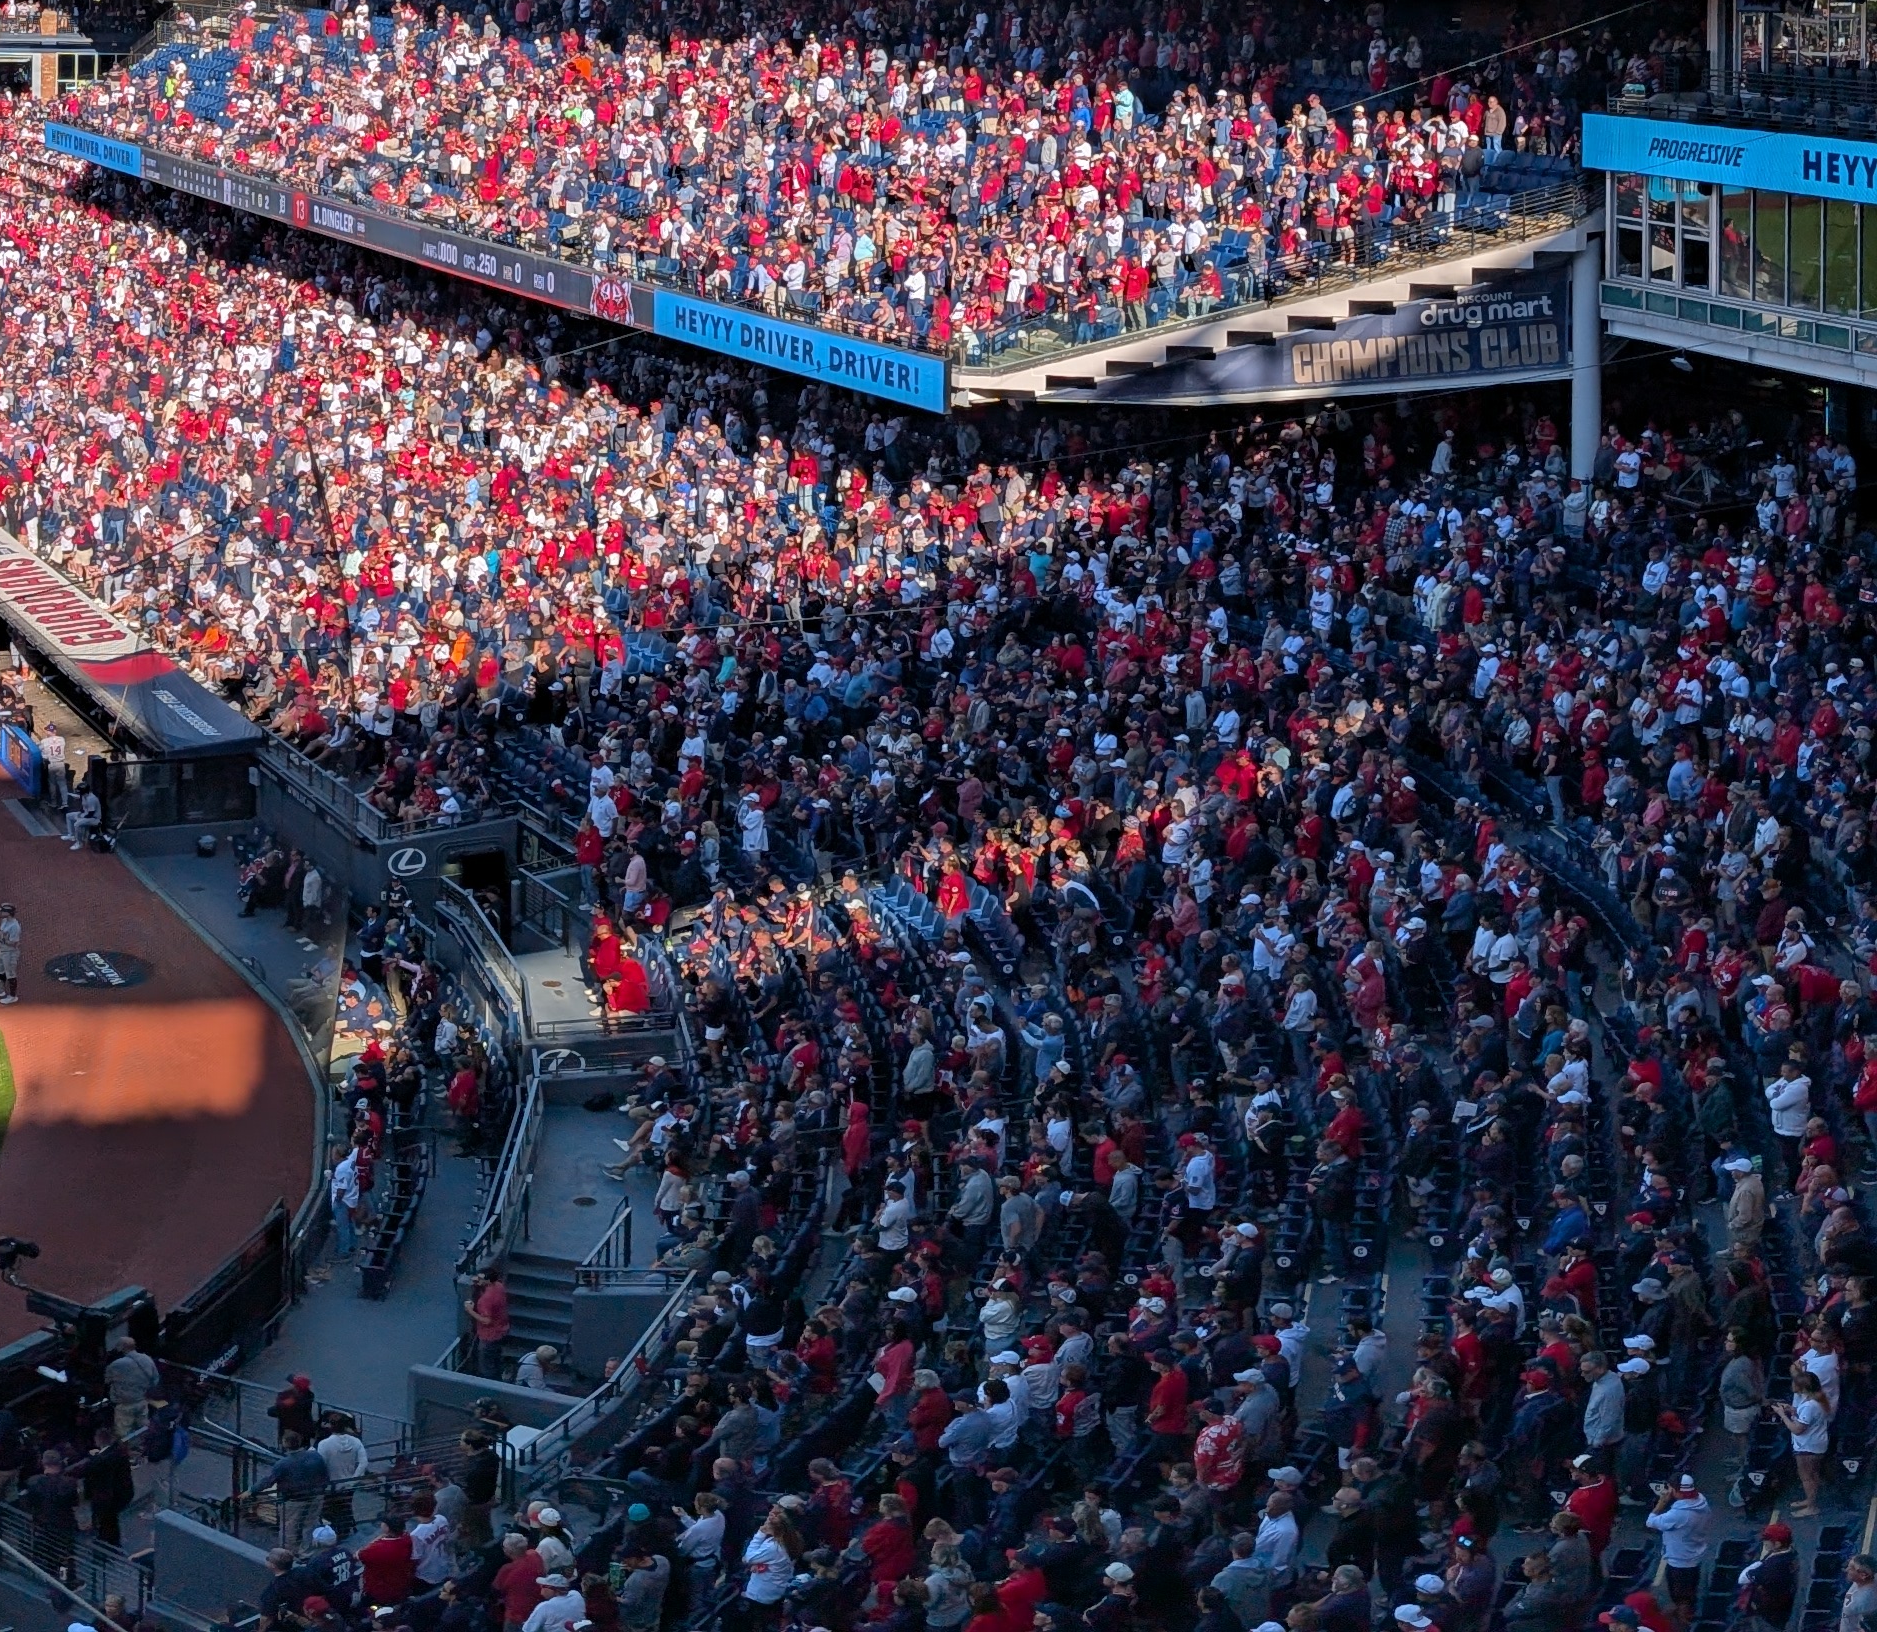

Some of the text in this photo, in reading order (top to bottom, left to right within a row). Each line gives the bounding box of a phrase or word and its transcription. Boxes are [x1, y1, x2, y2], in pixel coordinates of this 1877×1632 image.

[1648, 137, 1746, 167] PROGRESSIVE
[295, 200, 353, 233] 13 DINGLER
[477, 253, 496, 276] .250
[1420, 295, 1553, 329] drug mart
[1456, 291, 1513, 306] DISCOUNT
[675, 306, 921, 395] HEYYY DRIVER, DRIVER!
[1292, 324, 1559, 385] CHAMPIONS CLUB
[49, 745, 62, 755] 14
